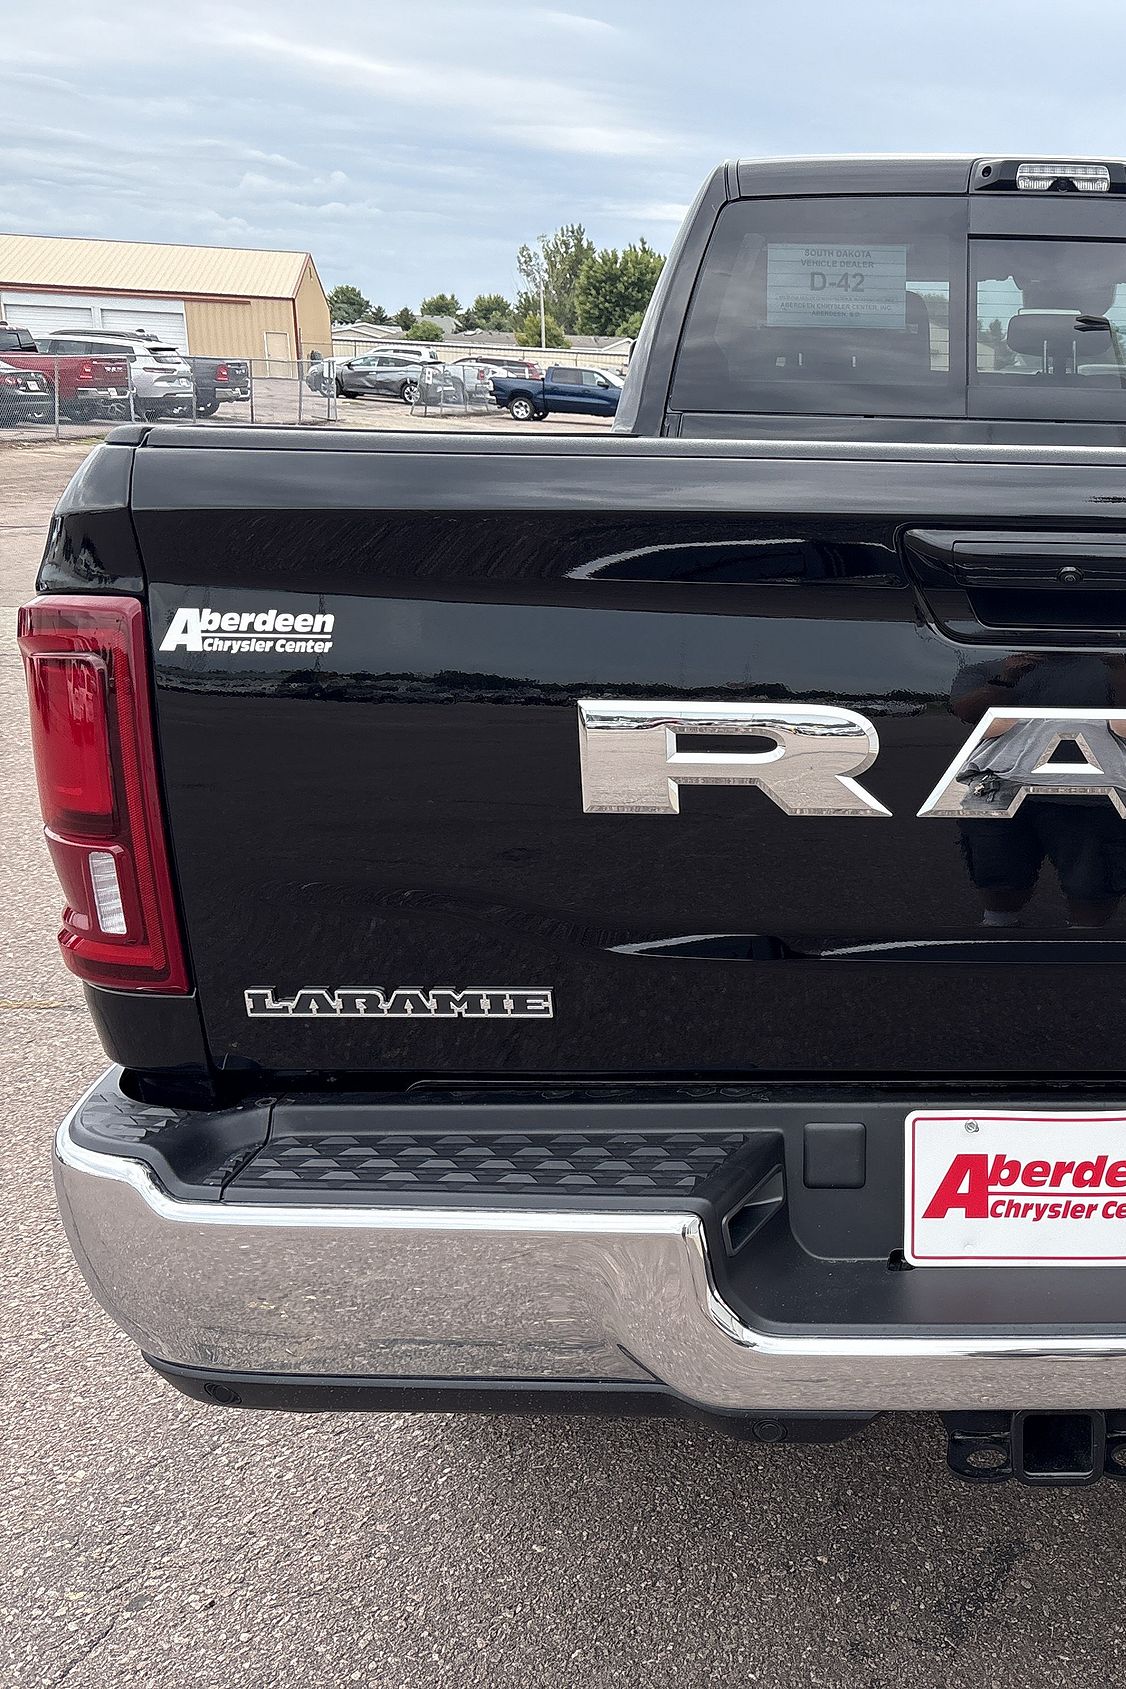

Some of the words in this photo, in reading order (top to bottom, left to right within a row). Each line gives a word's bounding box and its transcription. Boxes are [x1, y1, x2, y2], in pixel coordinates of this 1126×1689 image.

[801, 259, 838, 268] VEHICLE
[839, 260, 875, 269] DEALER
[804, 249, 834, 258] SOUTH
[836, 250, 872, 259] DAKOTA
[810, 271, 865, 293] D-42
[158, 607, 335, 652] Aberdeen
[203, 638, 274, 654] Chrysler
[275, 639, 333, 654] Center
[243, 986, 554, 1019] LARAMIE
[989, 1199, 1098, 1222] Chrysler
